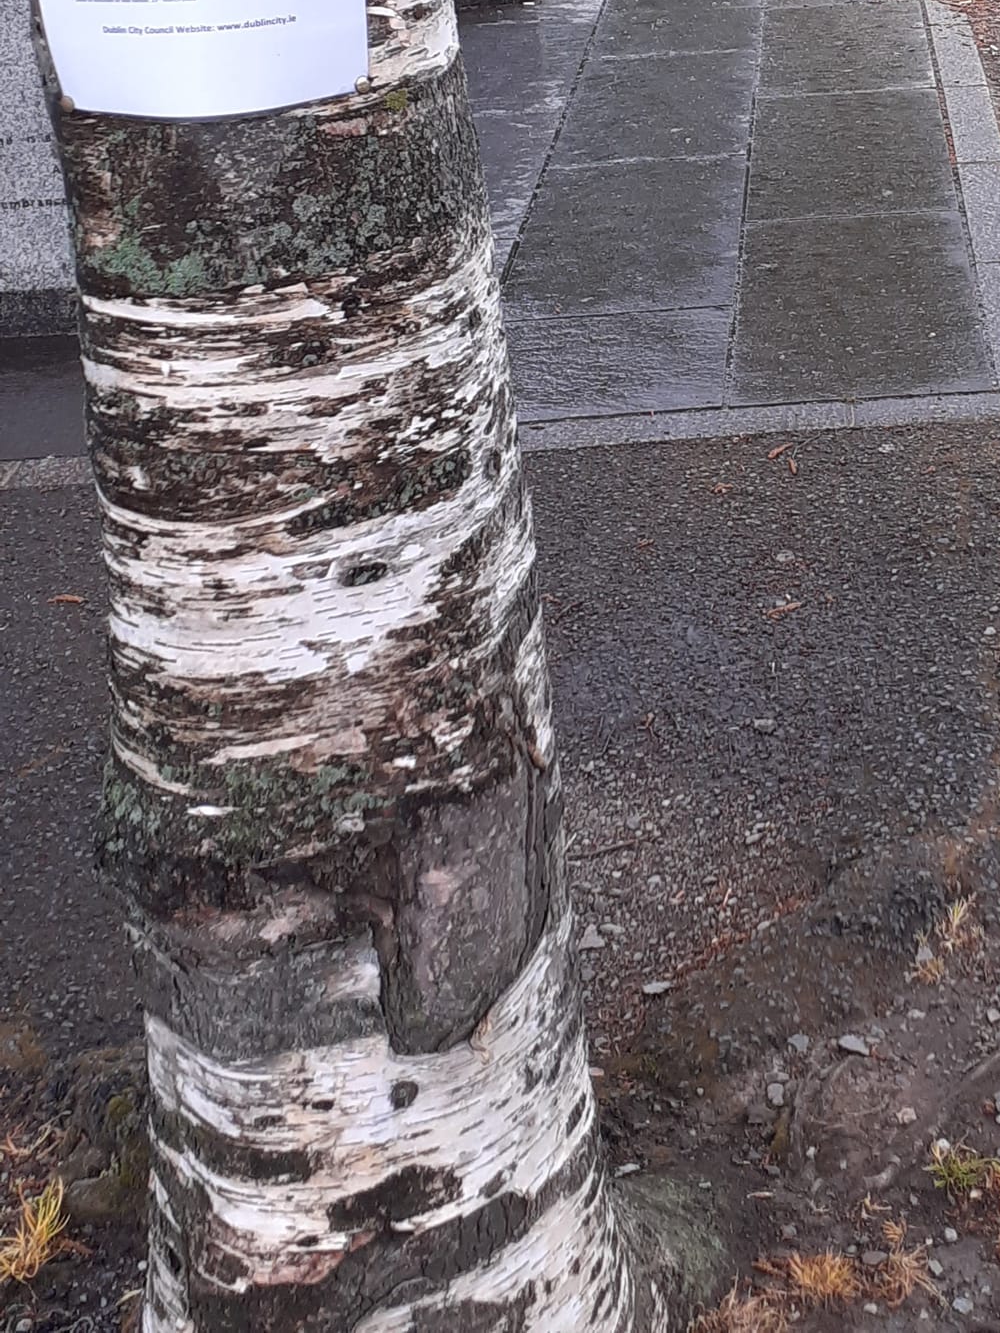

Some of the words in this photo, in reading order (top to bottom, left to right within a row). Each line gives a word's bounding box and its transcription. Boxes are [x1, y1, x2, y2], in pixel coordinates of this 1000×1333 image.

[103, 25, 127, 34] Dublin
[128, 25, 143, 36] City
[144, 25, 174, 34] Council
[175, 24, 216, 34] Website:
[216, 14, 297, 31] www.dublincity.ie
